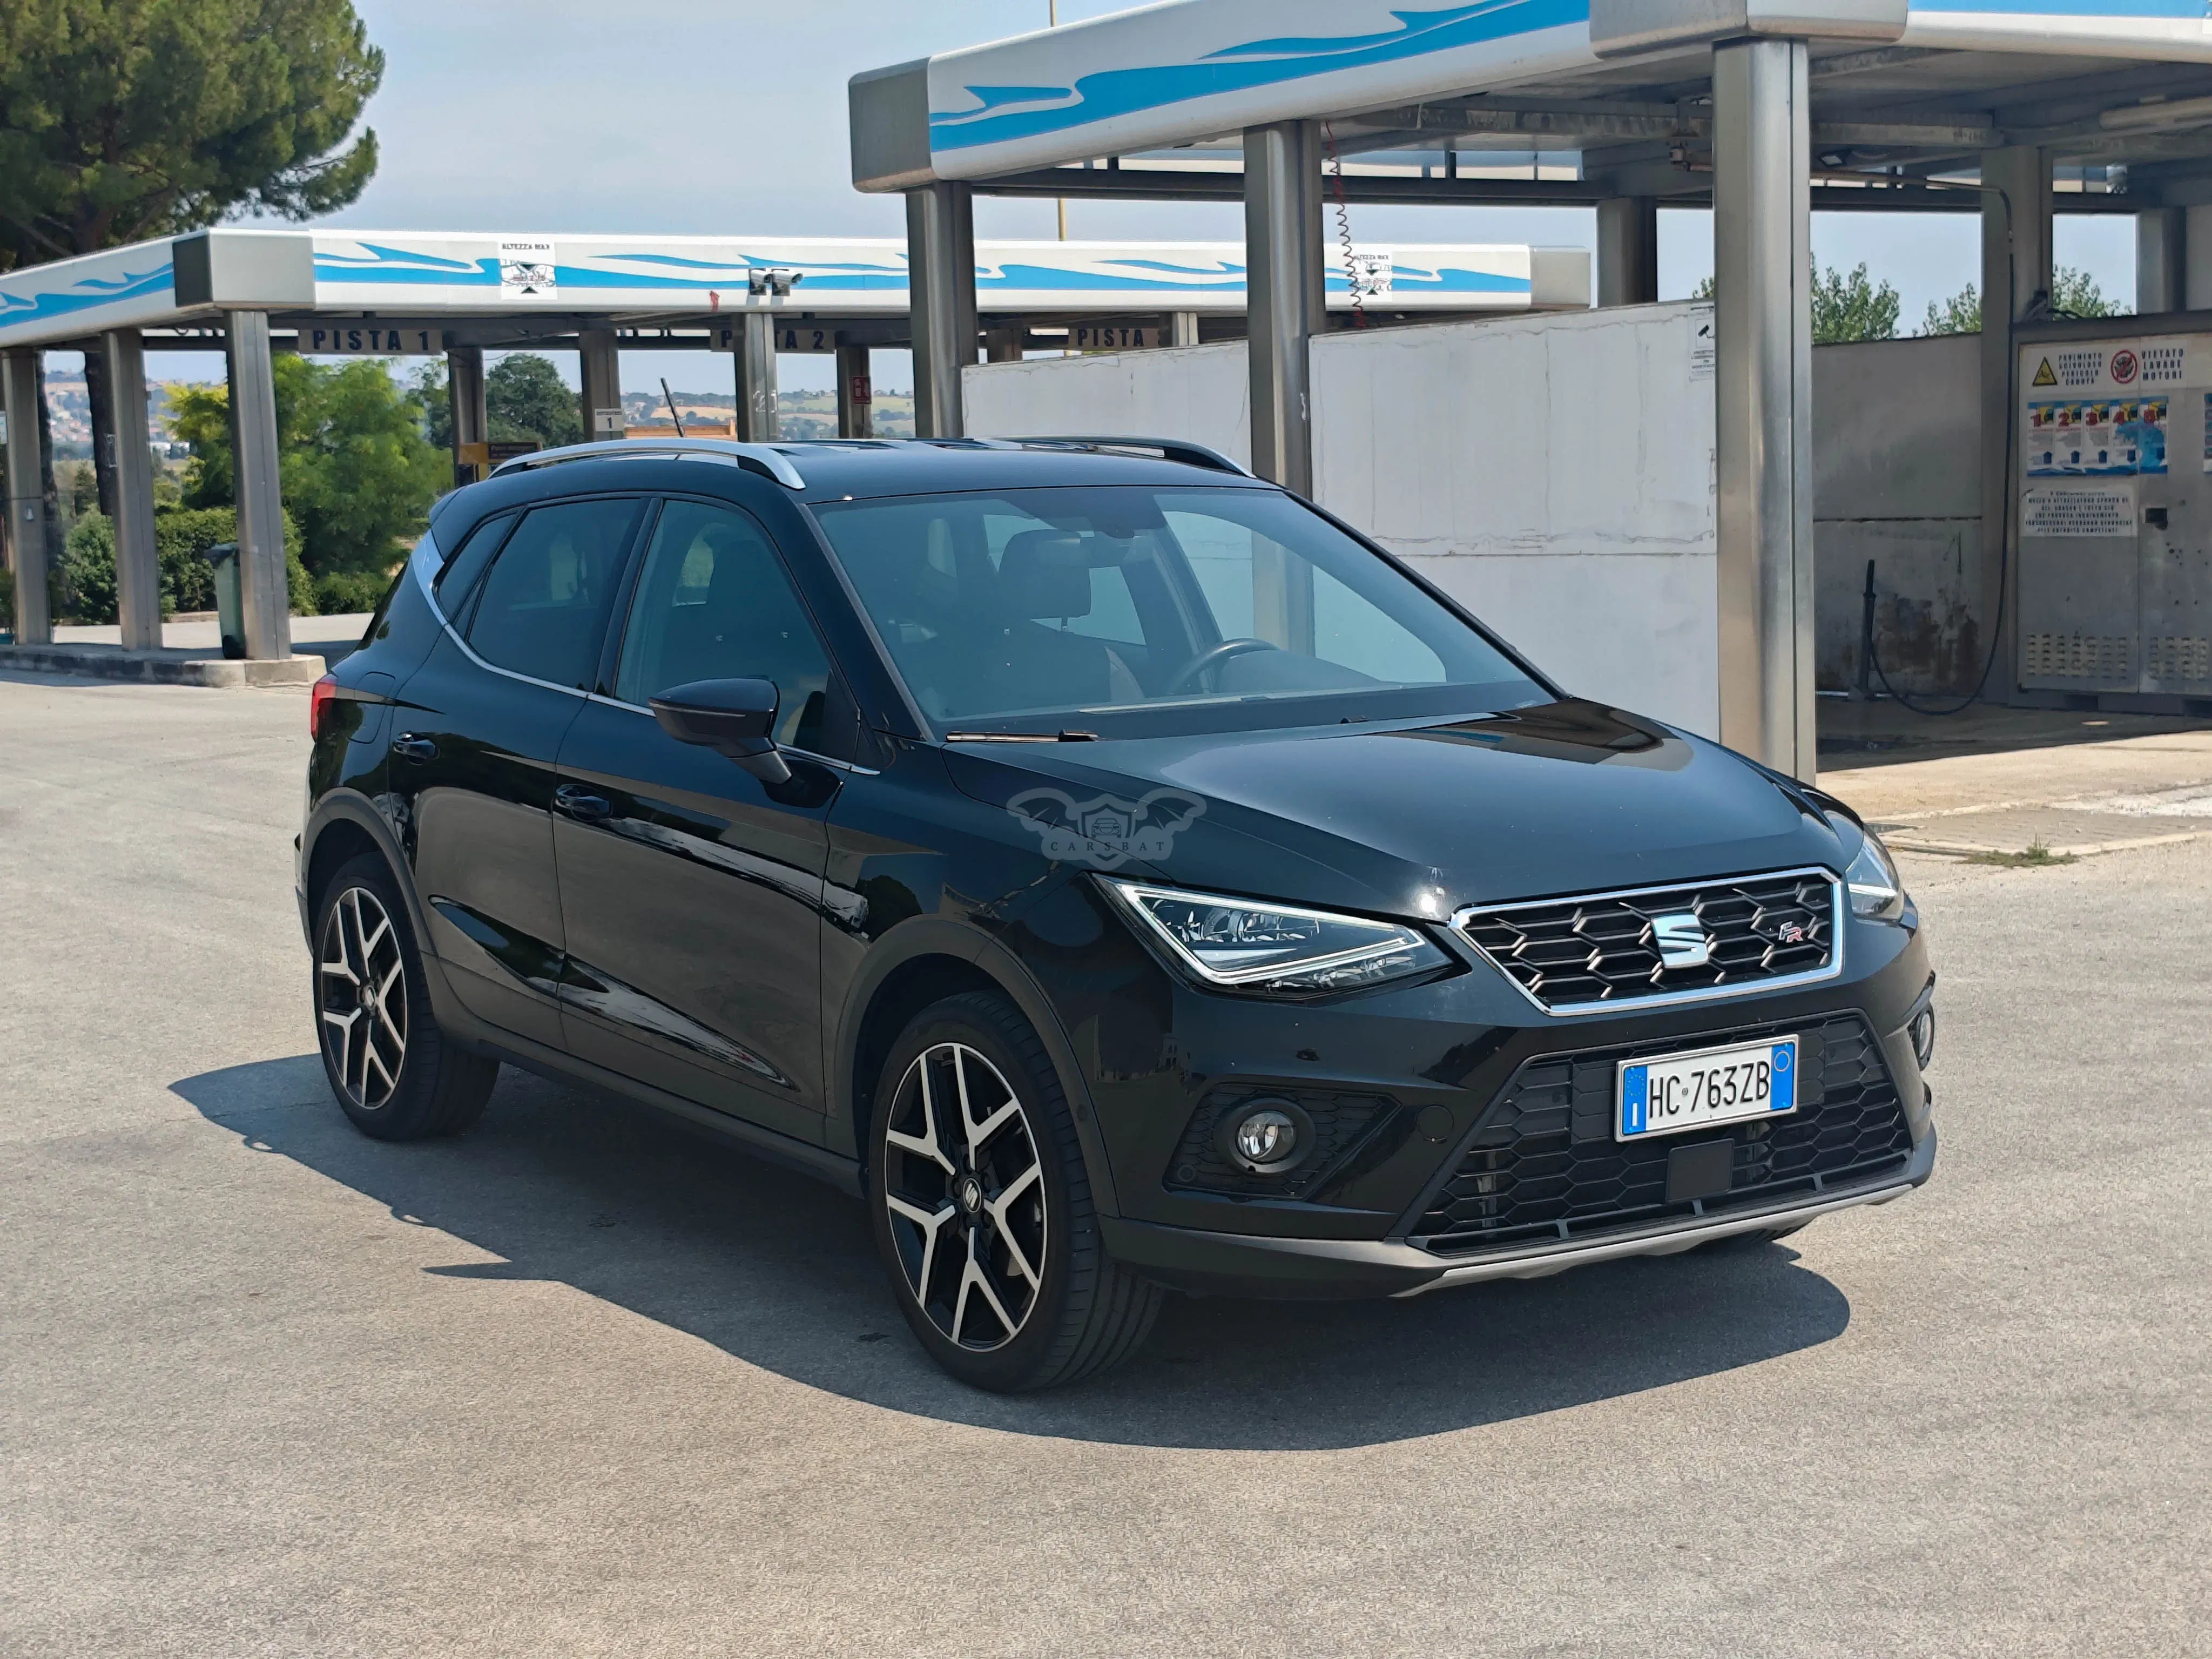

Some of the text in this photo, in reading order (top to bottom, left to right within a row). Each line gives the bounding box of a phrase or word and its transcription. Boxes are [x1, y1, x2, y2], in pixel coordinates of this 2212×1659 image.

[313, 330, 429, 350] PISTA 1
[721, 330, 824, 349] PTA 2
[1077, 329, 1144, 347] PISTA
[2141, 348, 2183, 359] VIETATO
[607, 417, 612, 429] 1
